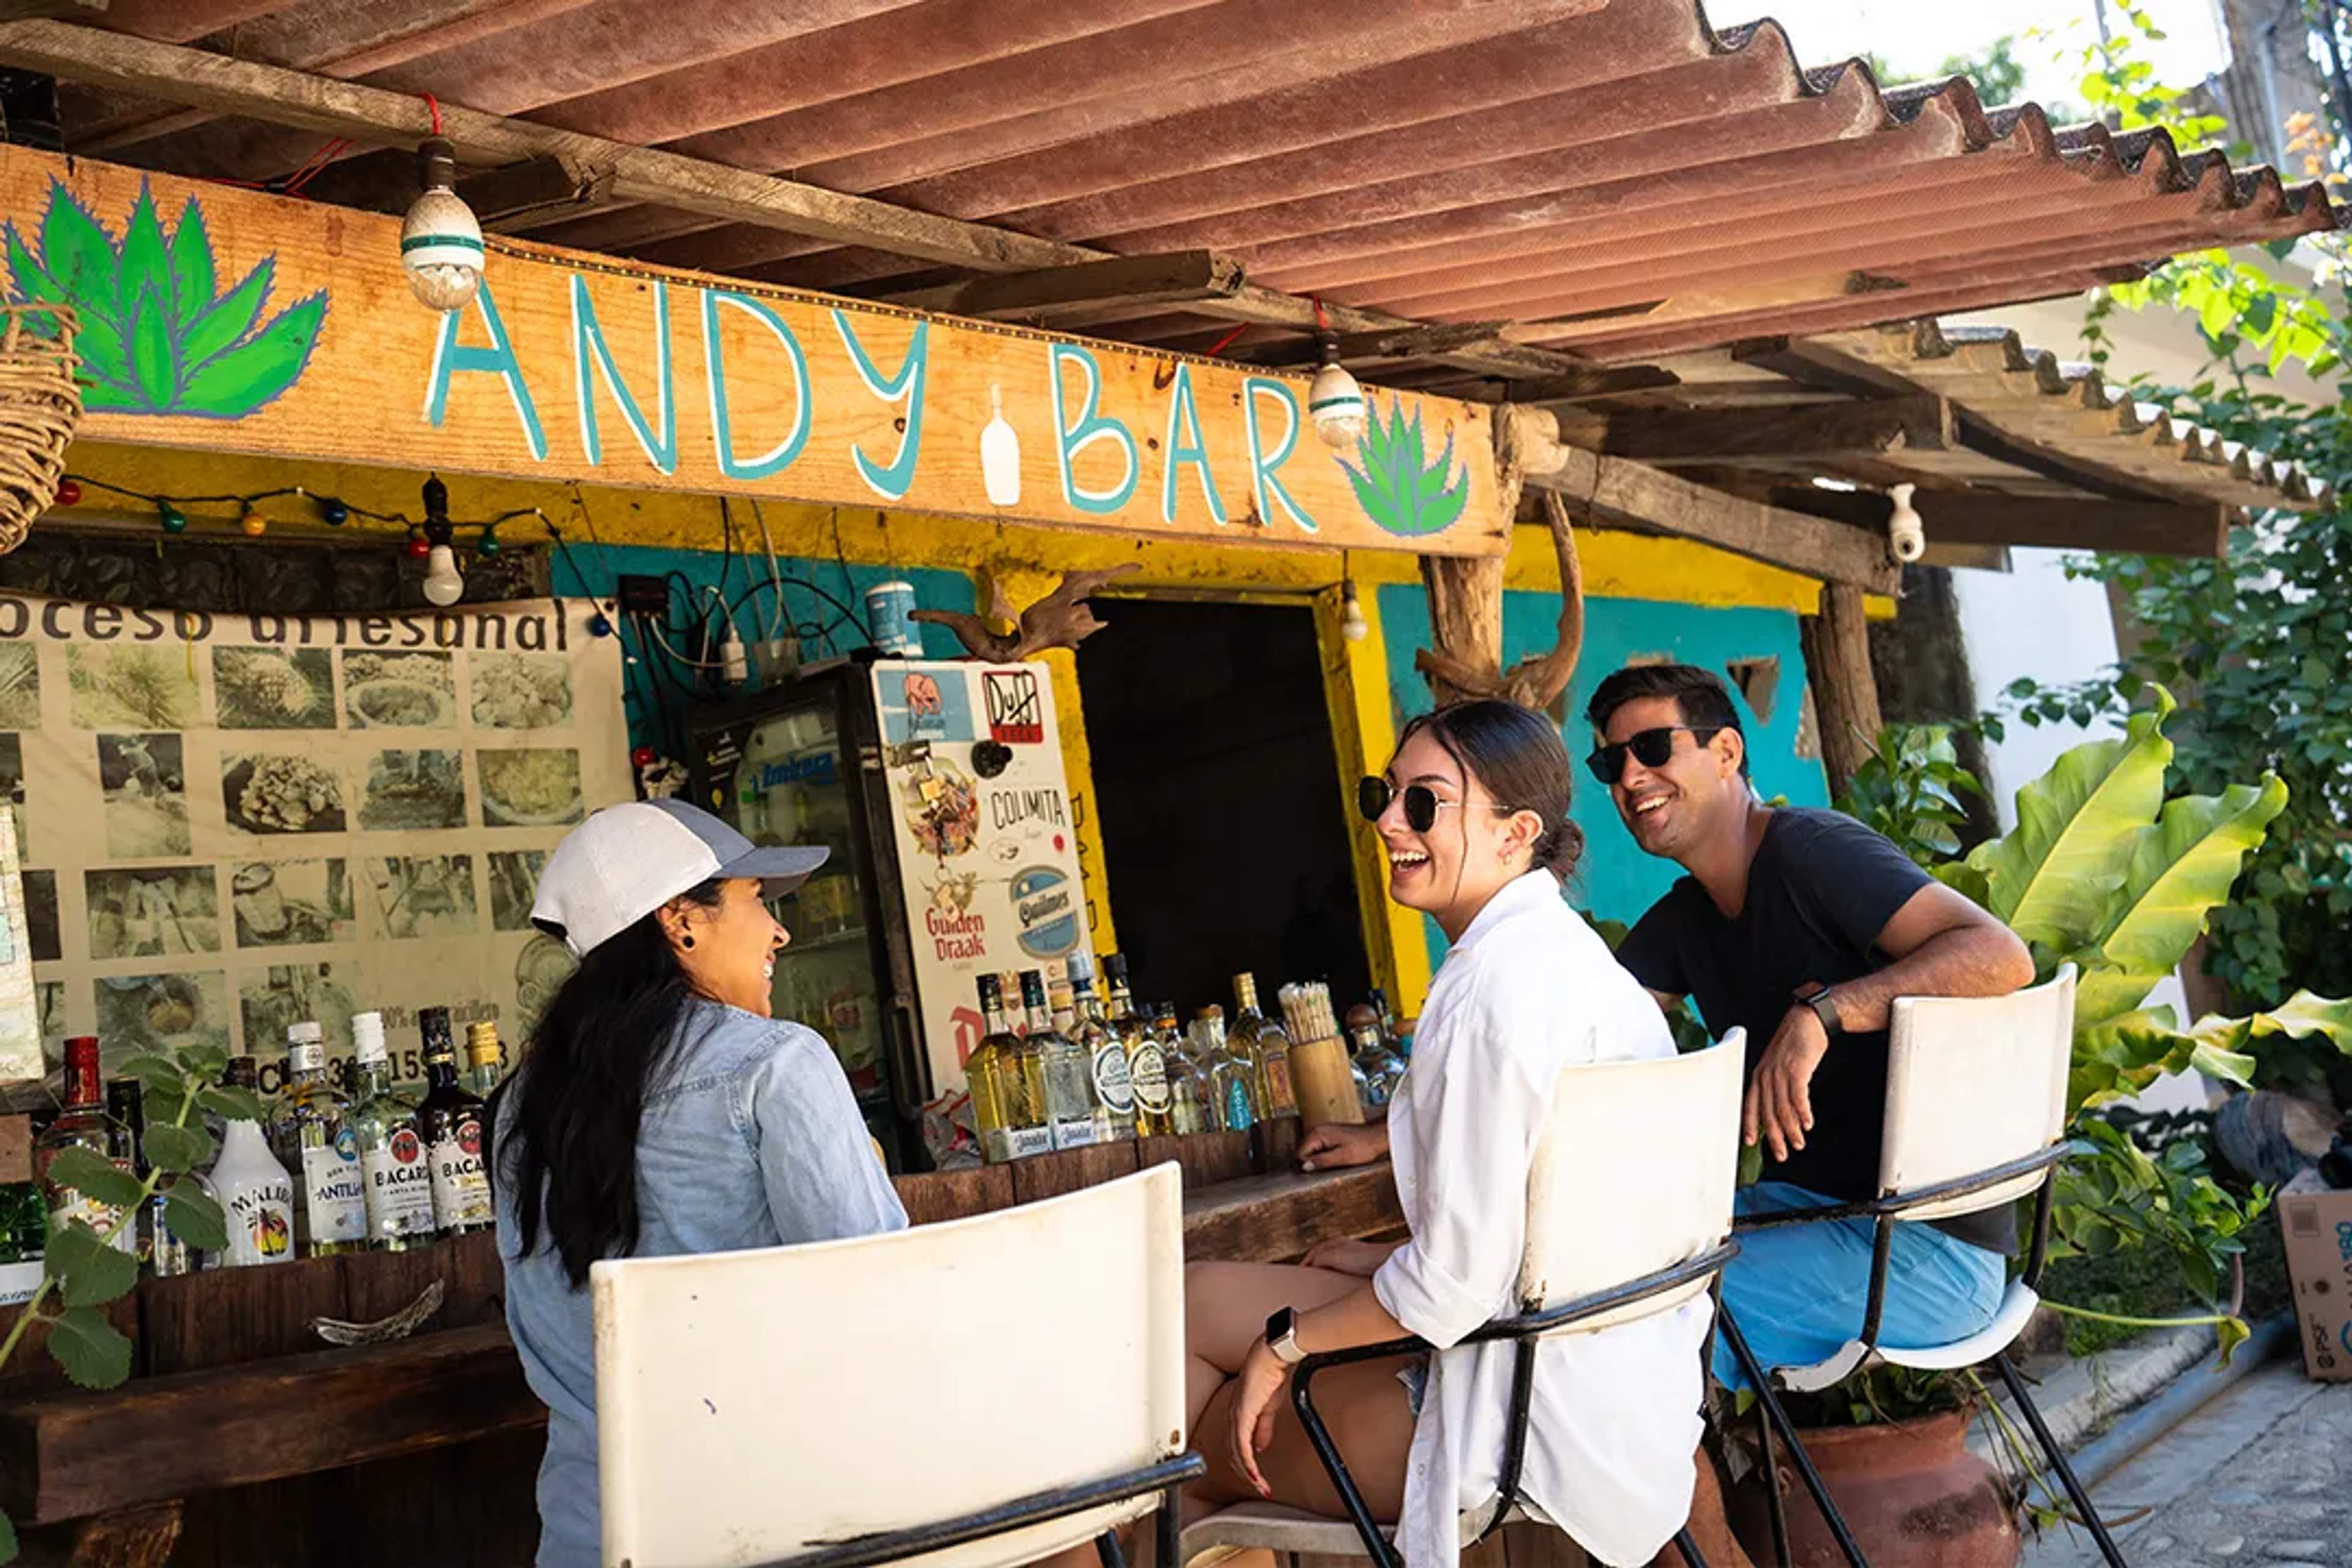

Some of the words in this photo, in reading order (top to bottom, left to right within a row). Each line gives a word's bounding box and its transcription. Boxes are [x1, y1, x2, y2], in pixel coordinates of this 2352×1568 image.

[423, 274, 928, 500] ANDY
[1048, 343, 1319, 534] BAR
[986, 670, 1037, 726] Duff
[990, 790, 1066, 830] COLIMITA
[935, 934, 986, 961] Draak
